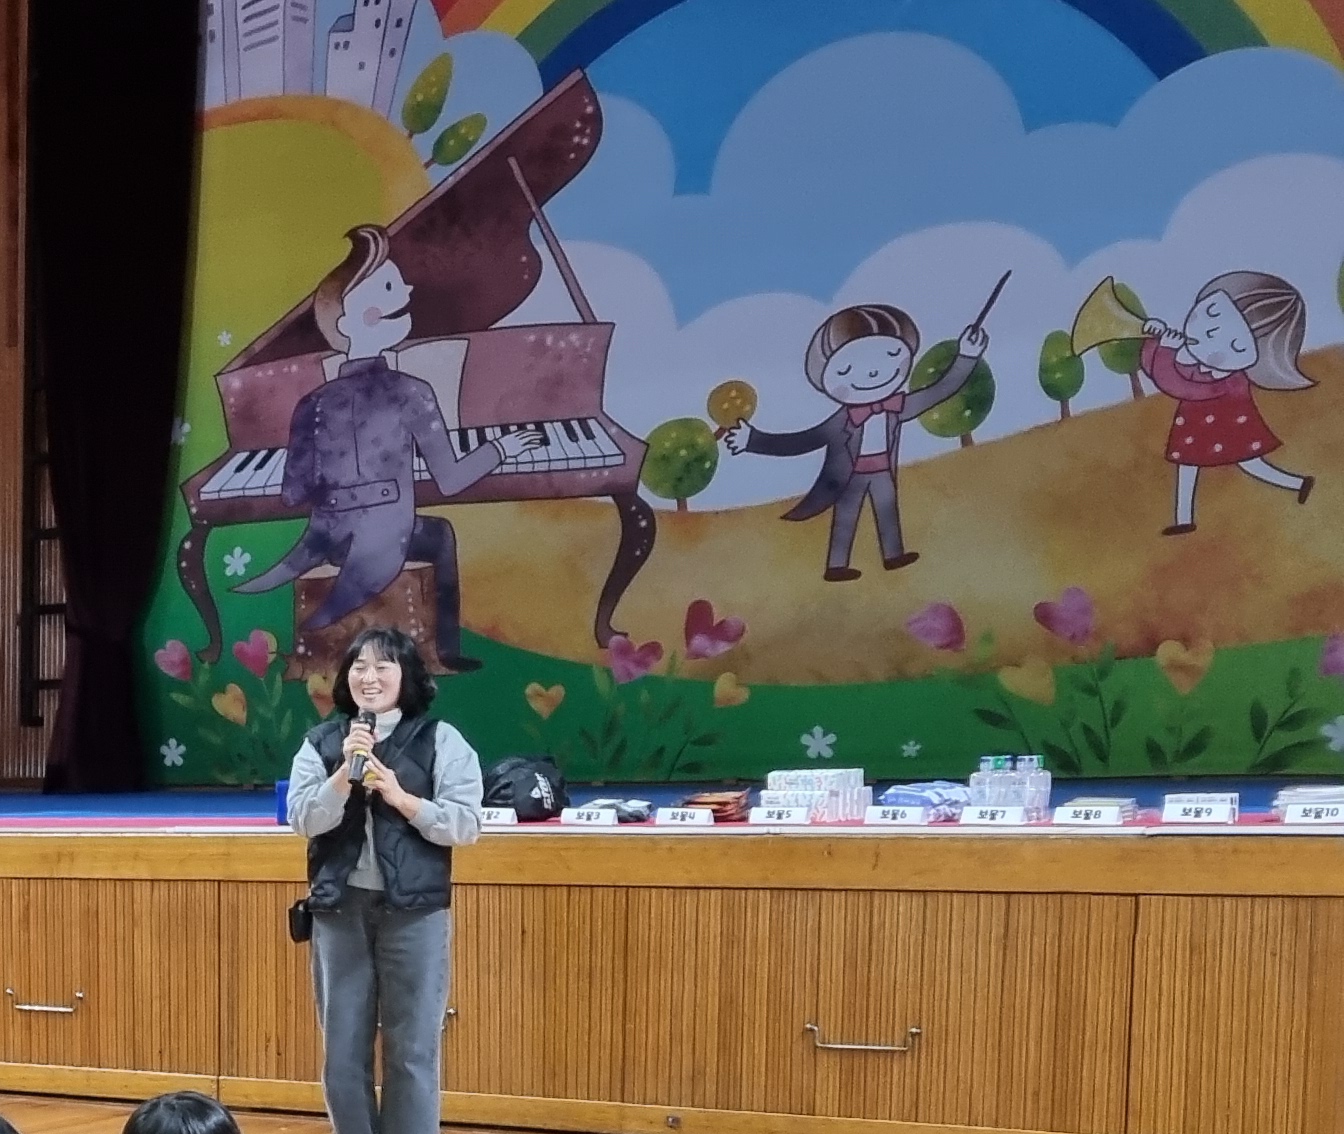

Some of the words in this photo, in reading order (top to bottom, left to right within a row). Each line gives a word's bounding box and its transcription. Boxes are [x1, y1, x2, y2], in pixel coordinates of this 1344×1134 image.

[575, 811, 601, 821] 보물3
[670, 811, 696, 821] 보물4
[765, 809, 792, 821] 보물5
[879, 809, 907, 821] 보물6
[977, 809, 1006, 822] 보물7
[1070, 809, 1102, 820] 보물8
[1180, 807, 1213, 819] 보물9
[1300, 807, 1340, 820] 보물10
